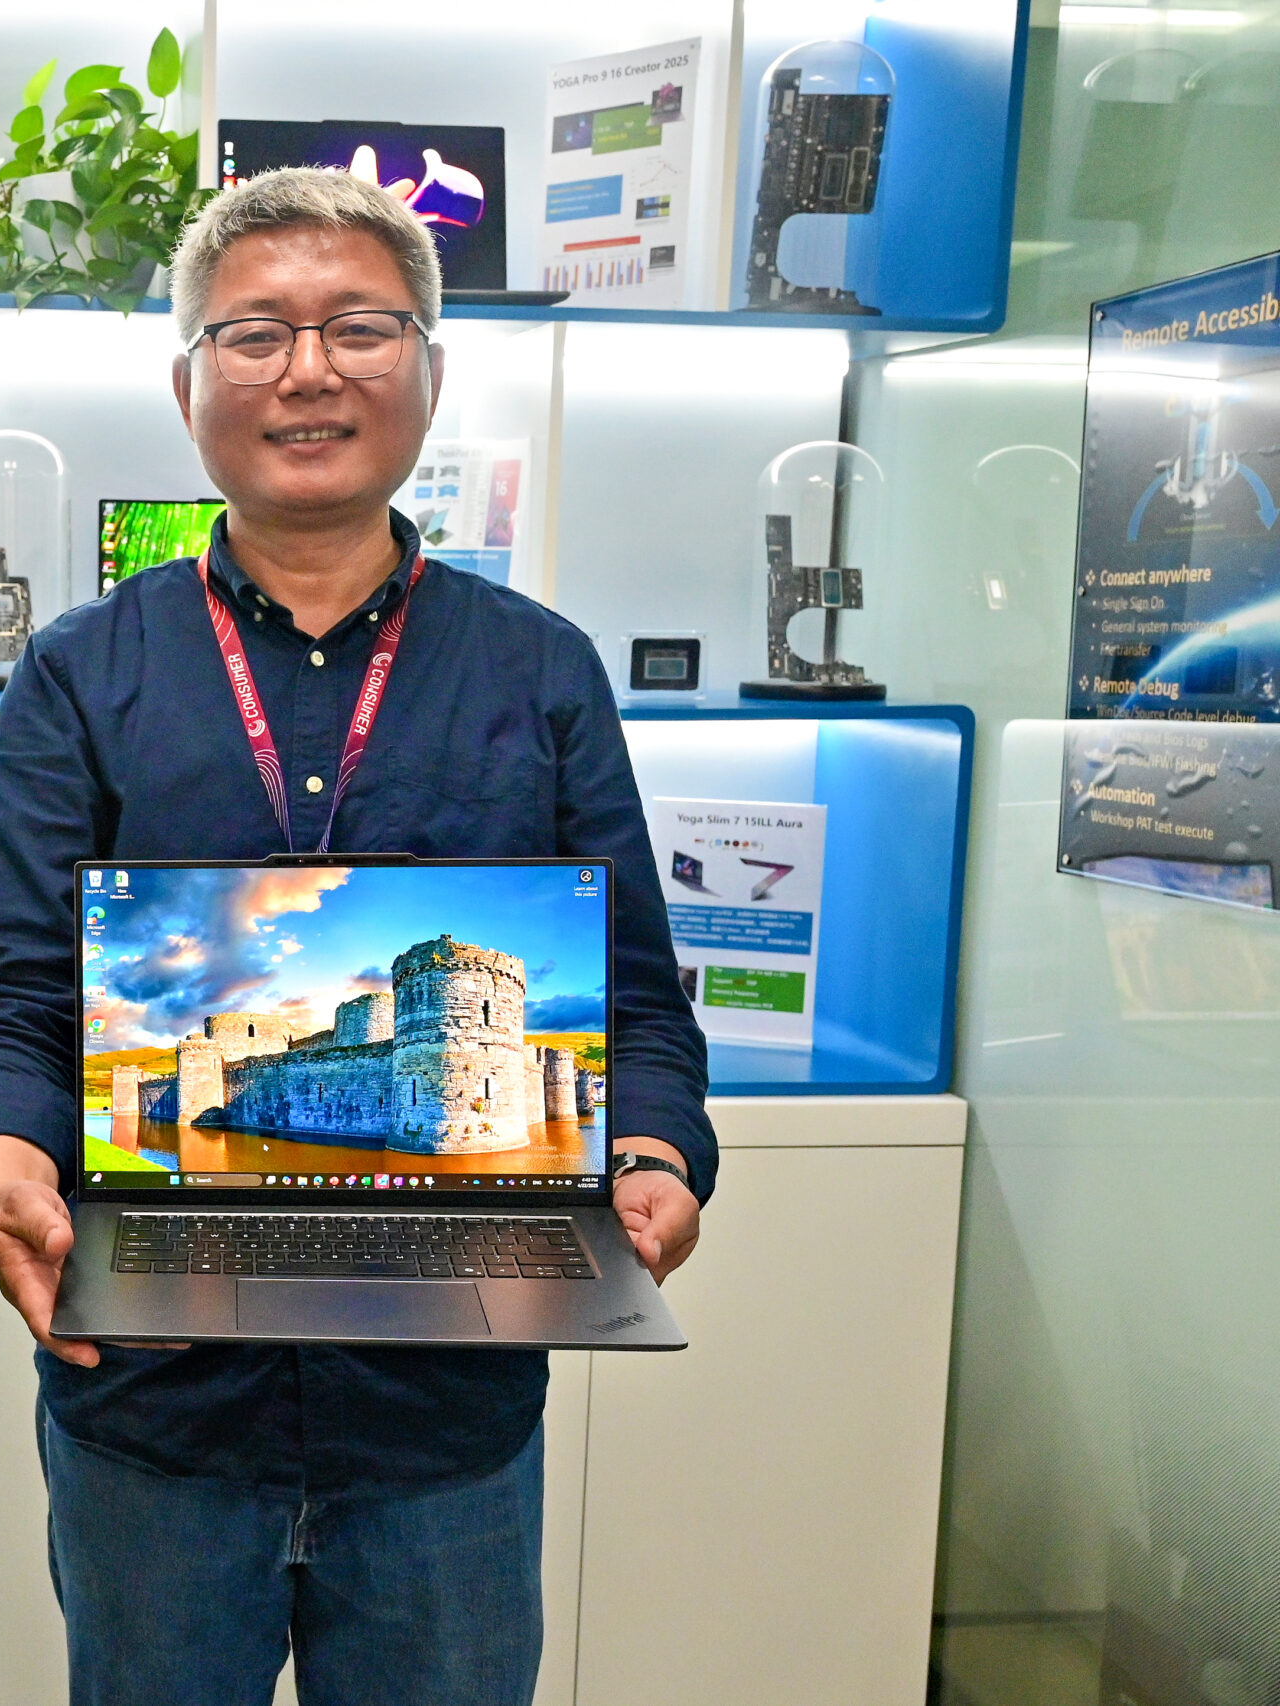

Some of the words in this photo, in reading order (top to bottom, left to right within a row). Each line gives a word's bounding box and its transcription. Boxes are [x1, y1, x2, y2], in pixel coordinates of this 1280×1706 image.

[552, 77, 579, 89] YOGA
[582, 74, 598, 84] Pro
[601, 70, 608, 80] 9
[610, 68, 622, 79] 16
[624, 62, 661, 76] Creator
[664, 54, 689, 69] 2025
[1120, 319, 1190, 352] Remote
[1194, 292, 1280, 338] Accessib
[496, 480, 508, 496] 16
[1100, 568, 1146, 586] Connect
[1148, 563, 1212, 588] anywhere
[1102, 598, 1128, 613] Single
[1130, 596, 1149, 612] Sign
[1150, 596, 1164, 609] On
[1102, 620, 1136, 632] General
[1137, 622, 1168, 634] system
[1170, 622, 1227, 638] monitoring
[228, 653, 259, 718] CONSUMER
[1093, 675, 1136, 694] Remote
[1138, 678, 1180, 700] Debug
[354, 668, 384, 736] CONSUMER
[1168, 708, 1193, 722] Code
[1196, 708, 1220, 722] level
[1222, 710, 1256, 726] debug
[1186, 734, 1208, 751] Logs
[1175, 756, 1216, 777] Flashing
[1088, 782, 1156, 806] Automation
[678, 814, 703, 826] Yoga
[707, 814, 730, 824] Slim
[734, 816, 740, 824] 7
[776, 818, 803, 828] Aura
[1091, 810, 1134, 830] Workshop
[1136, 815, 1152, 830] PAT
[1154, 820, 1172, 835] test
[1175, 824, 1214, 841] execute
[586, 1312, 649, 1334] ThinkPad
